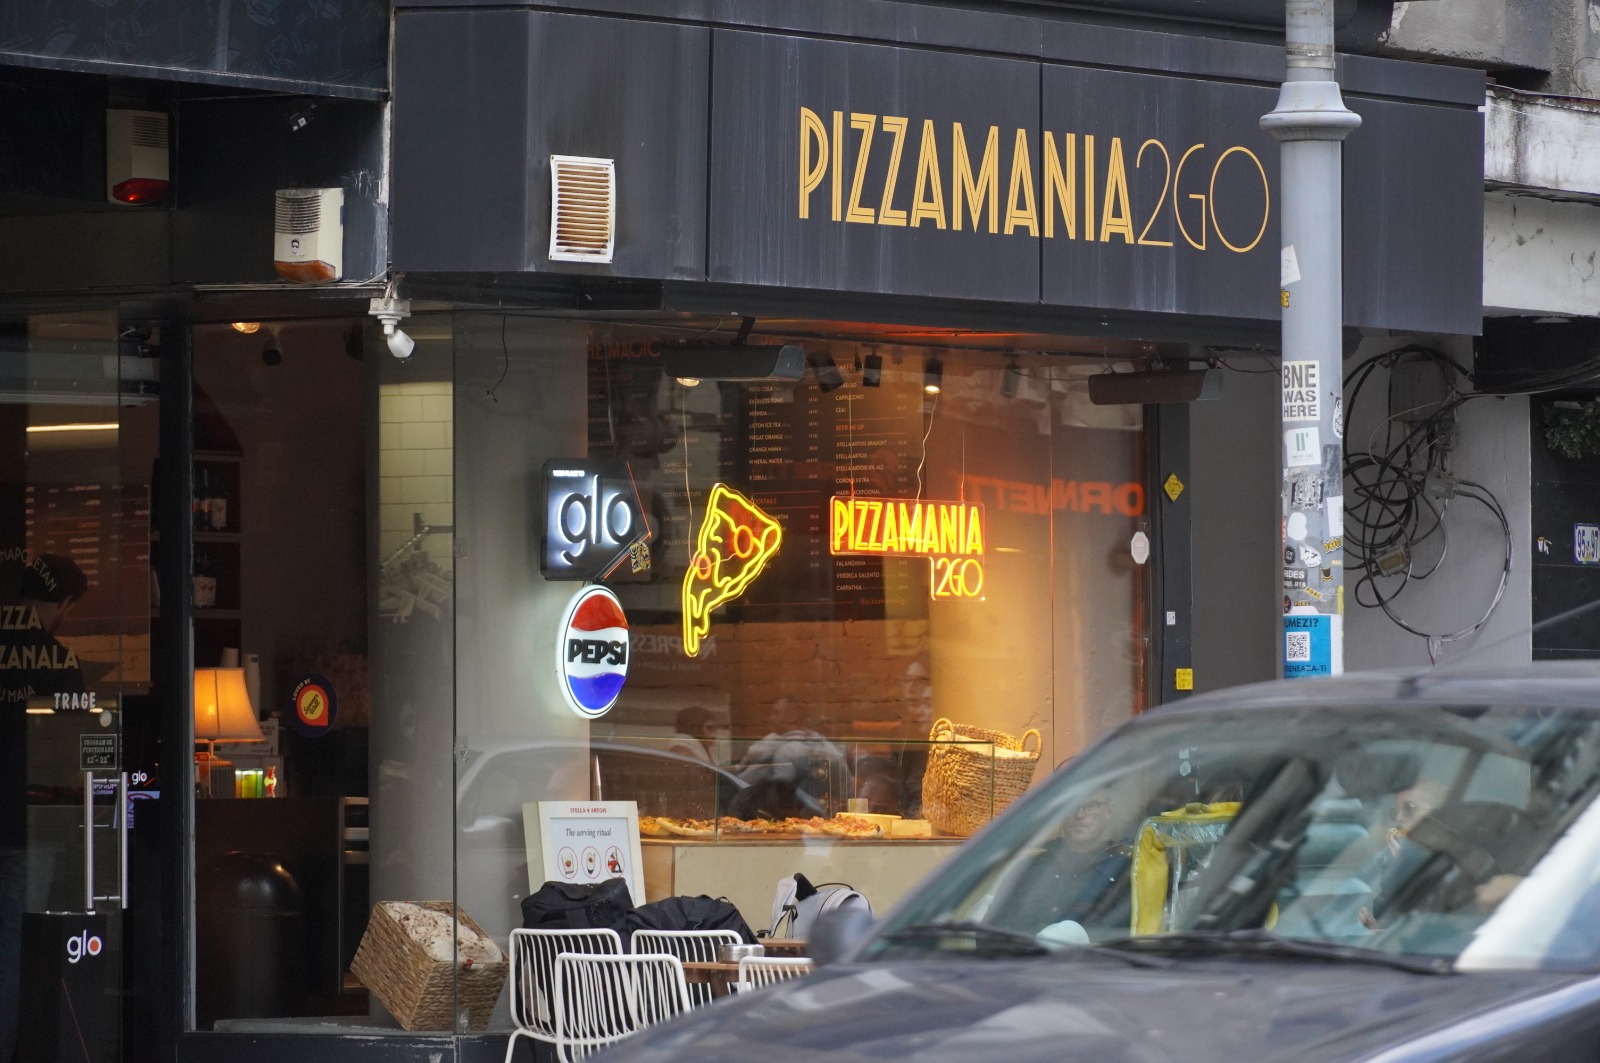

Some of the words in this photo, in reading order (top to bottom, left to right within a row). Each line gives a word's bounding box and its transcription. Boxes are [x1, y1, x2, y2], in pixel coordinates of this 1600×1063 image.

[1283, 364, 1316, 389] BNE
[1284, 390, 1316, 403] WAS
[1283, 404, 1317, 417] HERE
[558, 474, 632, 566] glo
[833, 500, 983, 555] PIZZAMANIA
[936, 558, 983, 597] 2GO
[0, 605, 42, 630] ZZA
[567, 638, 627, 666] PEPSI
[54, 691, 97, 710] TRAGE
[131, 770, 148, 785] glo
[565, 828, 575, 838] The
[576, 830, 598, 839] serving
[598, 827, 612, 837] ritual
[66, 929, 102, 964] glo
